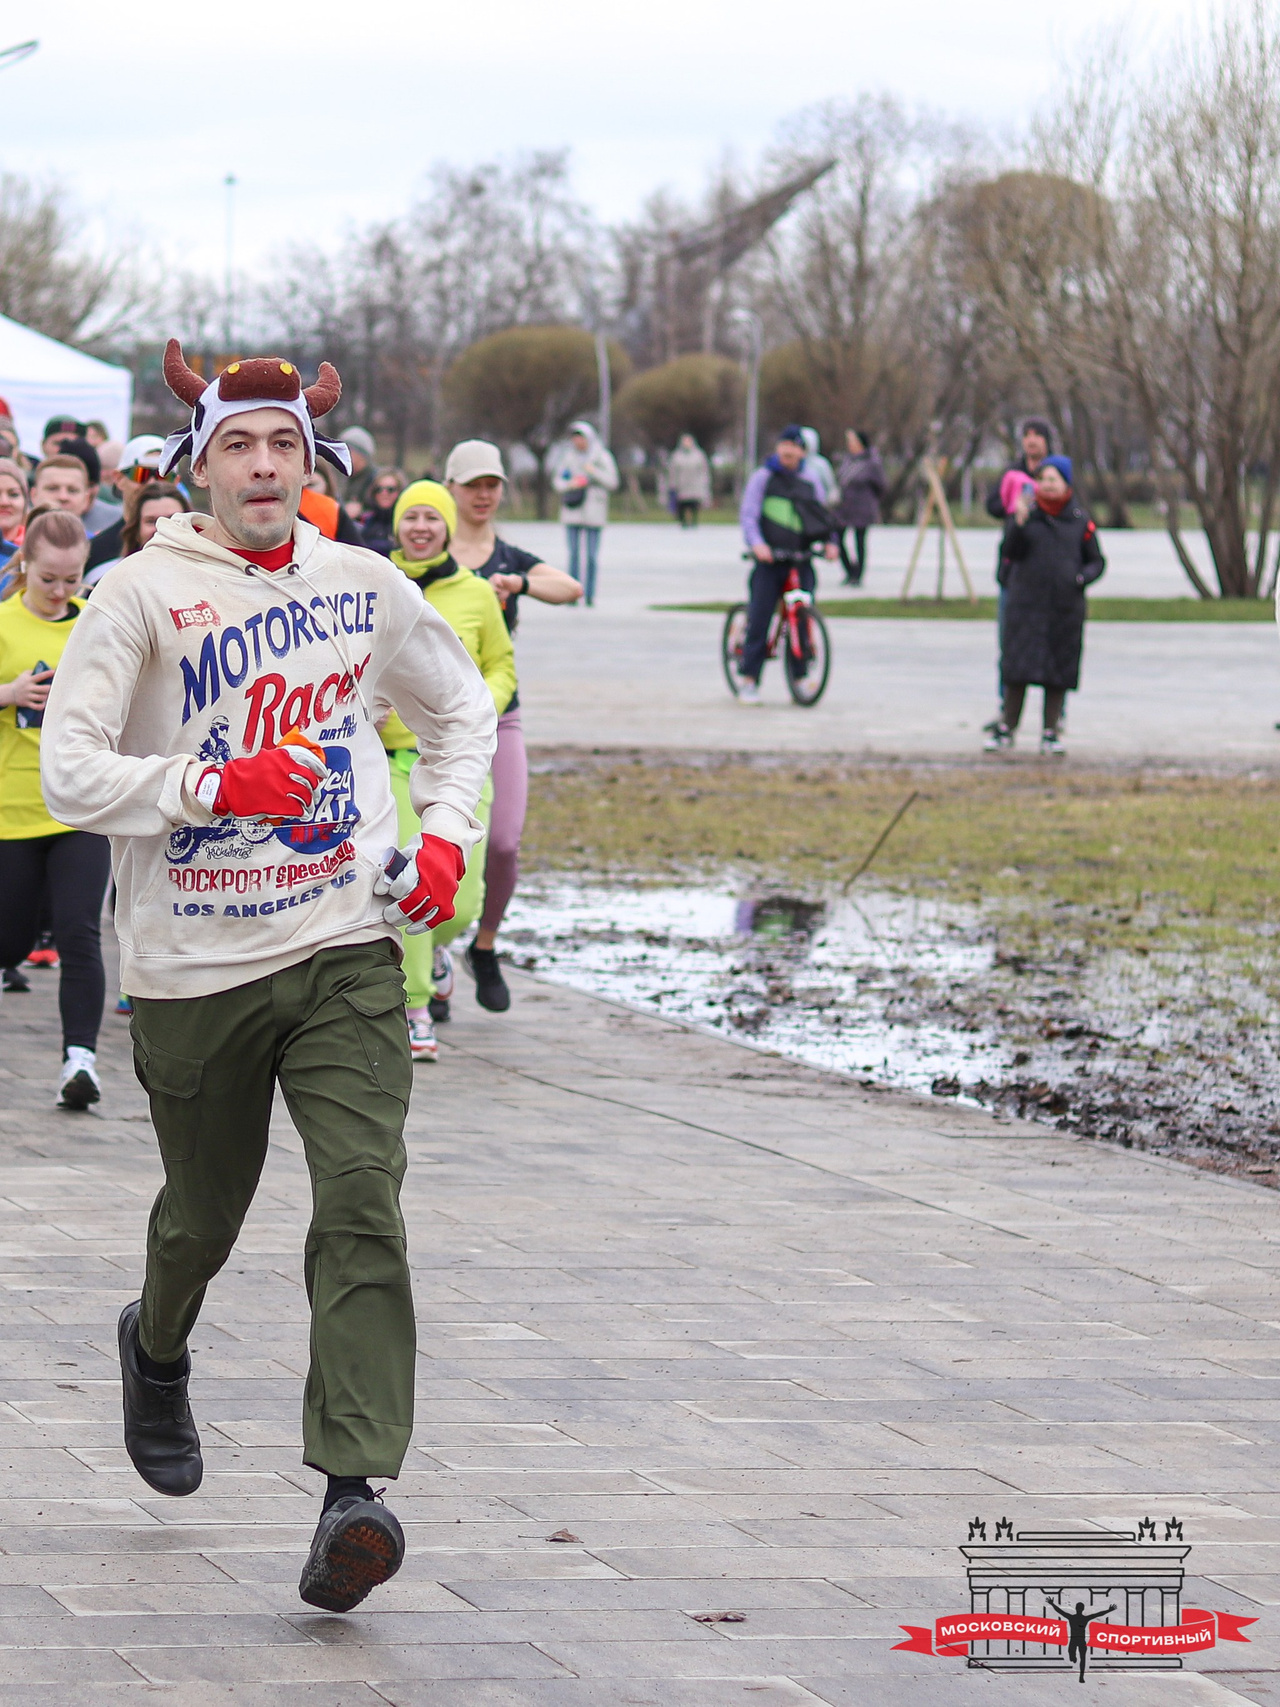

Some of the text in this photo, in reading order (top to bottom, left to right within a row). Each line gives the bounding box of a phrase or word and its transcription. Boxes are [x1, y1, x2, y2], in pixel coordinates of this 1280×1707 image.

[178, 608, 215, 628] 1958
[179, 592, 378, 727] MOTORCYCLE
[169, 865, 275, 894] ROCKPORT
[173, 868, 357, 918] LOS ANGELES US
